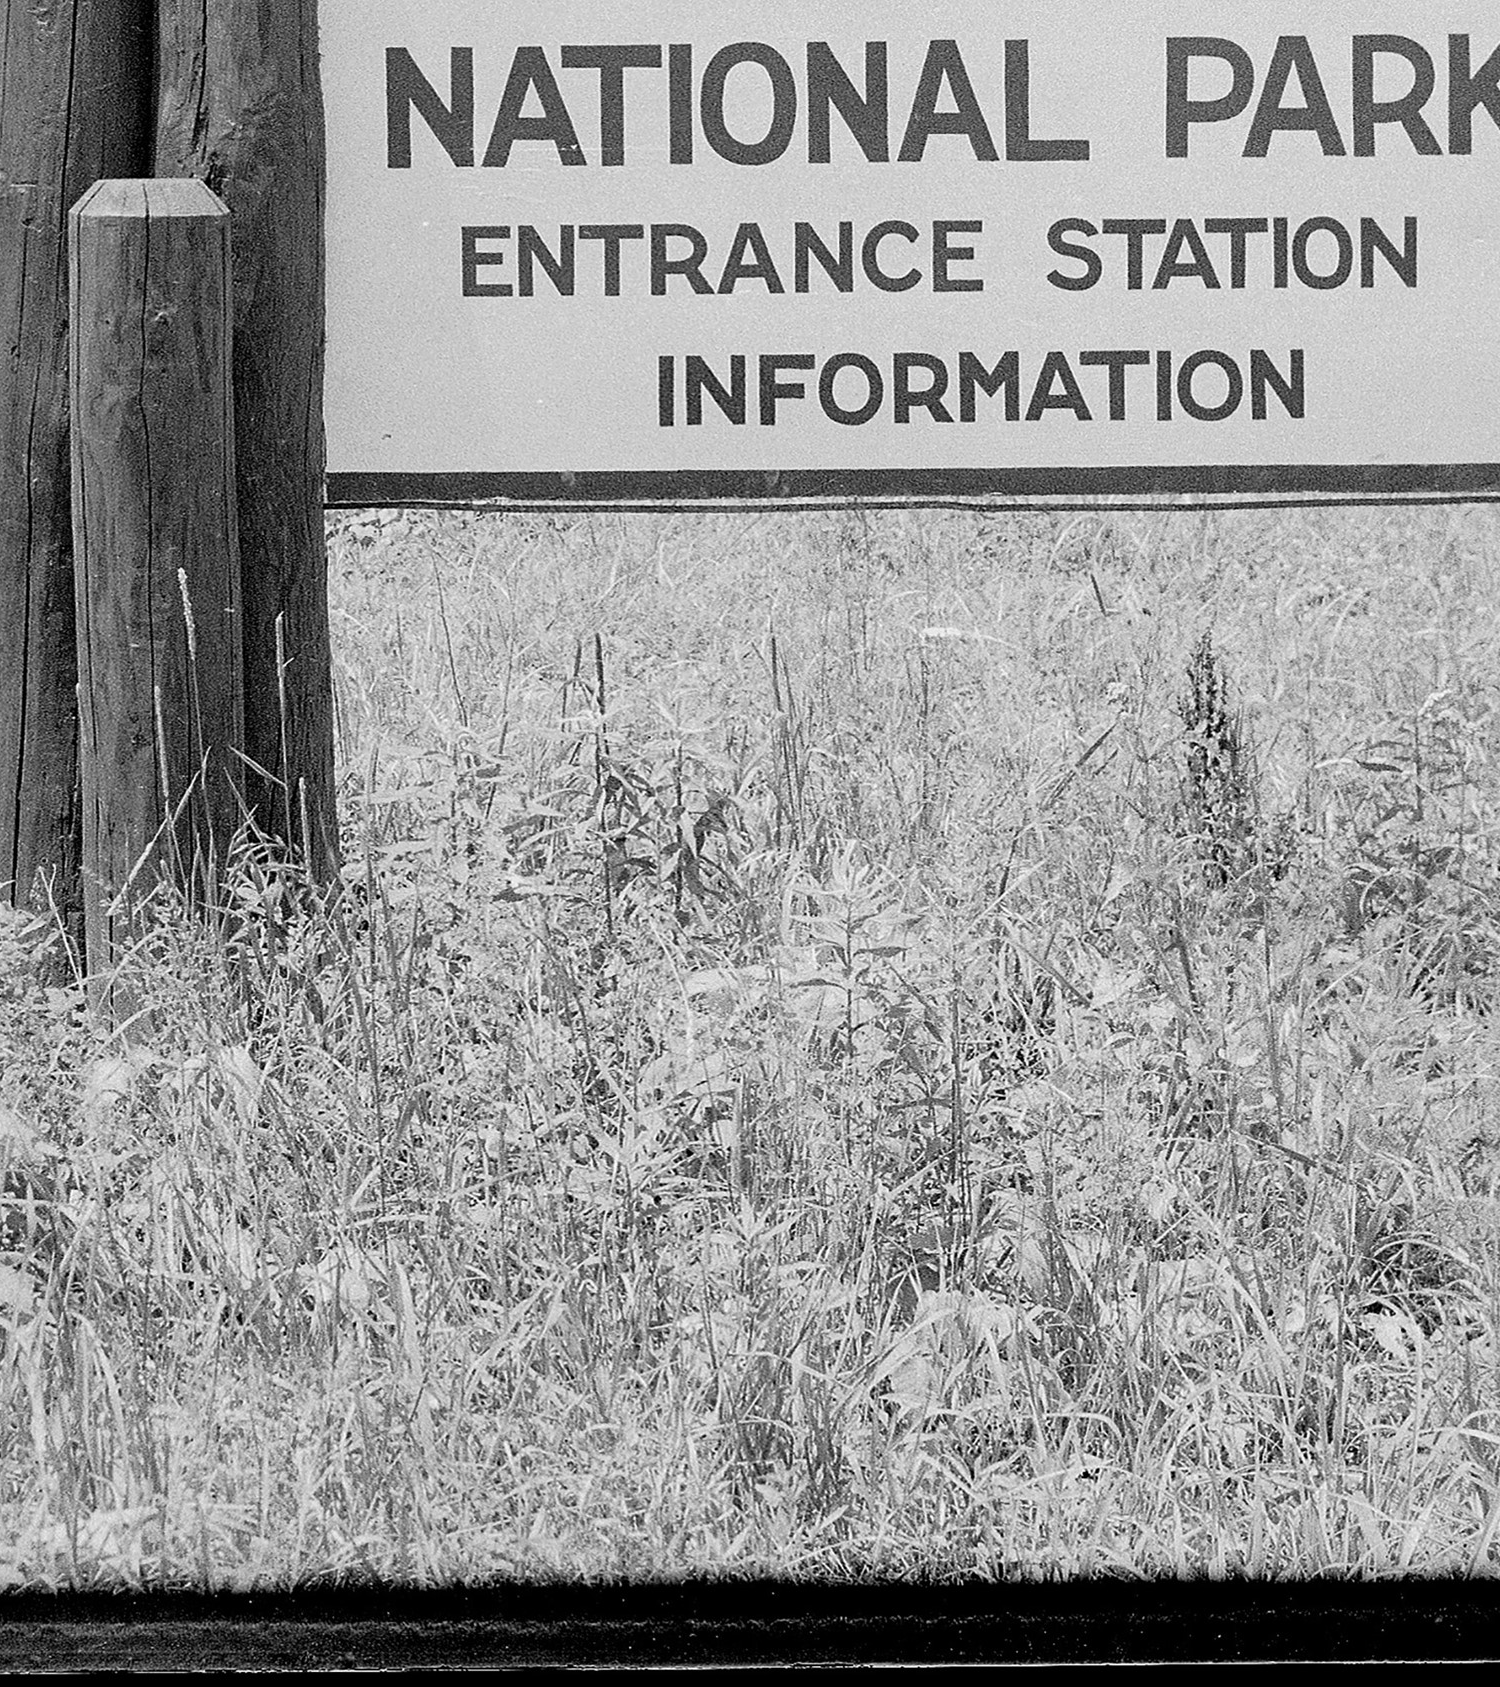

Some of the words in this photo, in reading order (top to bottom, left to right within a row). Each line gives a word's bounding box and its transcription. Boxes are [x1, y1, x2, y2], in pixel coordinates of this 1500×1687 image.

[385, 38, 1090, 169] NATIONAL
[460, 219, 984, 298] ENTRANCE
[1046, 216, 1418, 292] STATION
[658, 348, 1305, 428] INFORMATION
